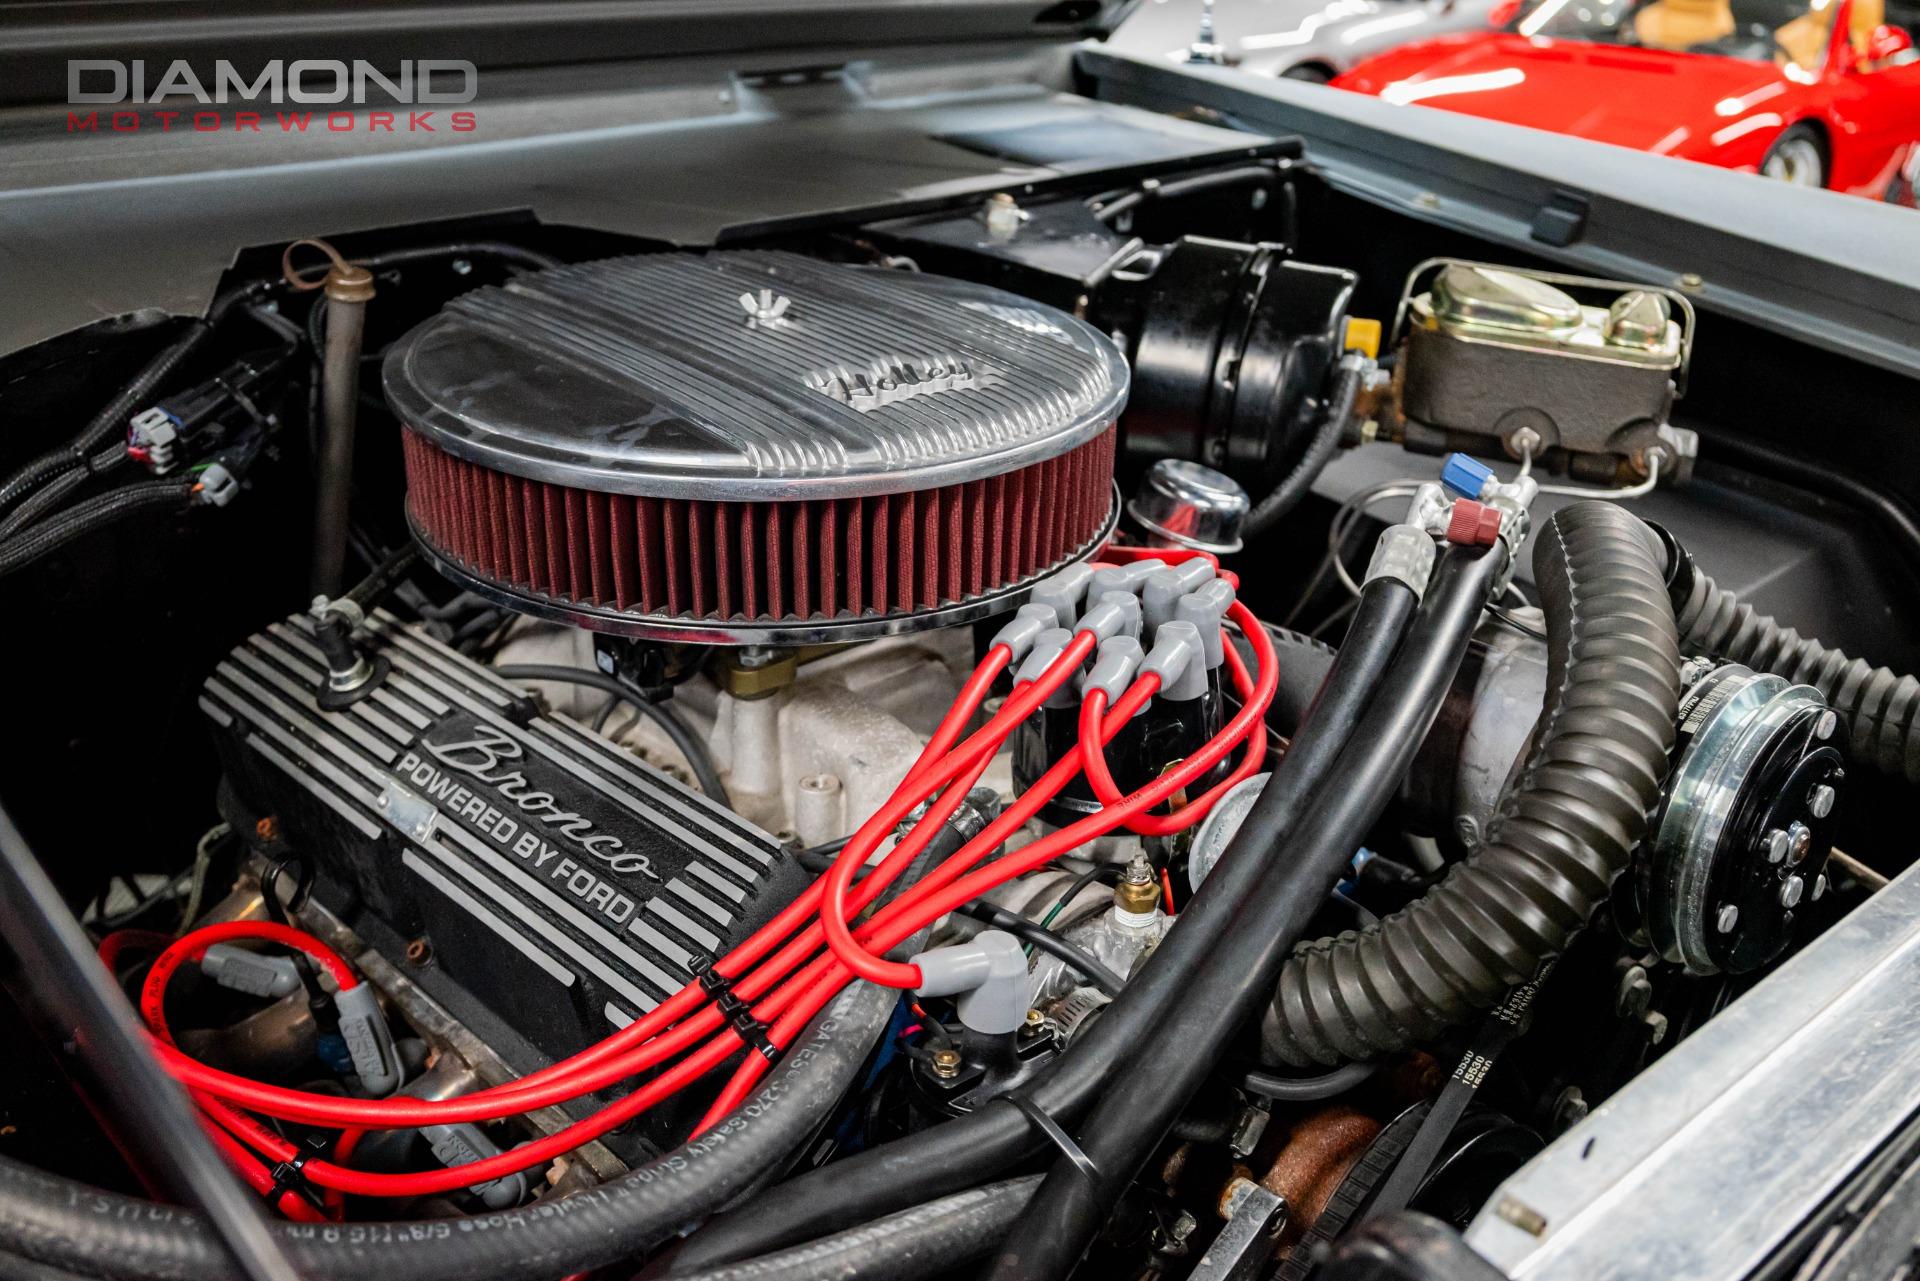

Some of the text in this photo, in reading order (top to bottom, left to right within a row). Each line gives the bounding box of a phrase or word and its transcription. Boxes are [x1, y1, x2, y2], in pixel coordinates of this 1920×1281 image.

[822, 361, 974, 402] Holley
[421, 725, 660, 879] Bronco
[396, 752, 635, 925] POWERED BY FORD
[1462, 1055, 1485, 1086] 15530
[686, 1115, 749, 1158] Safety
